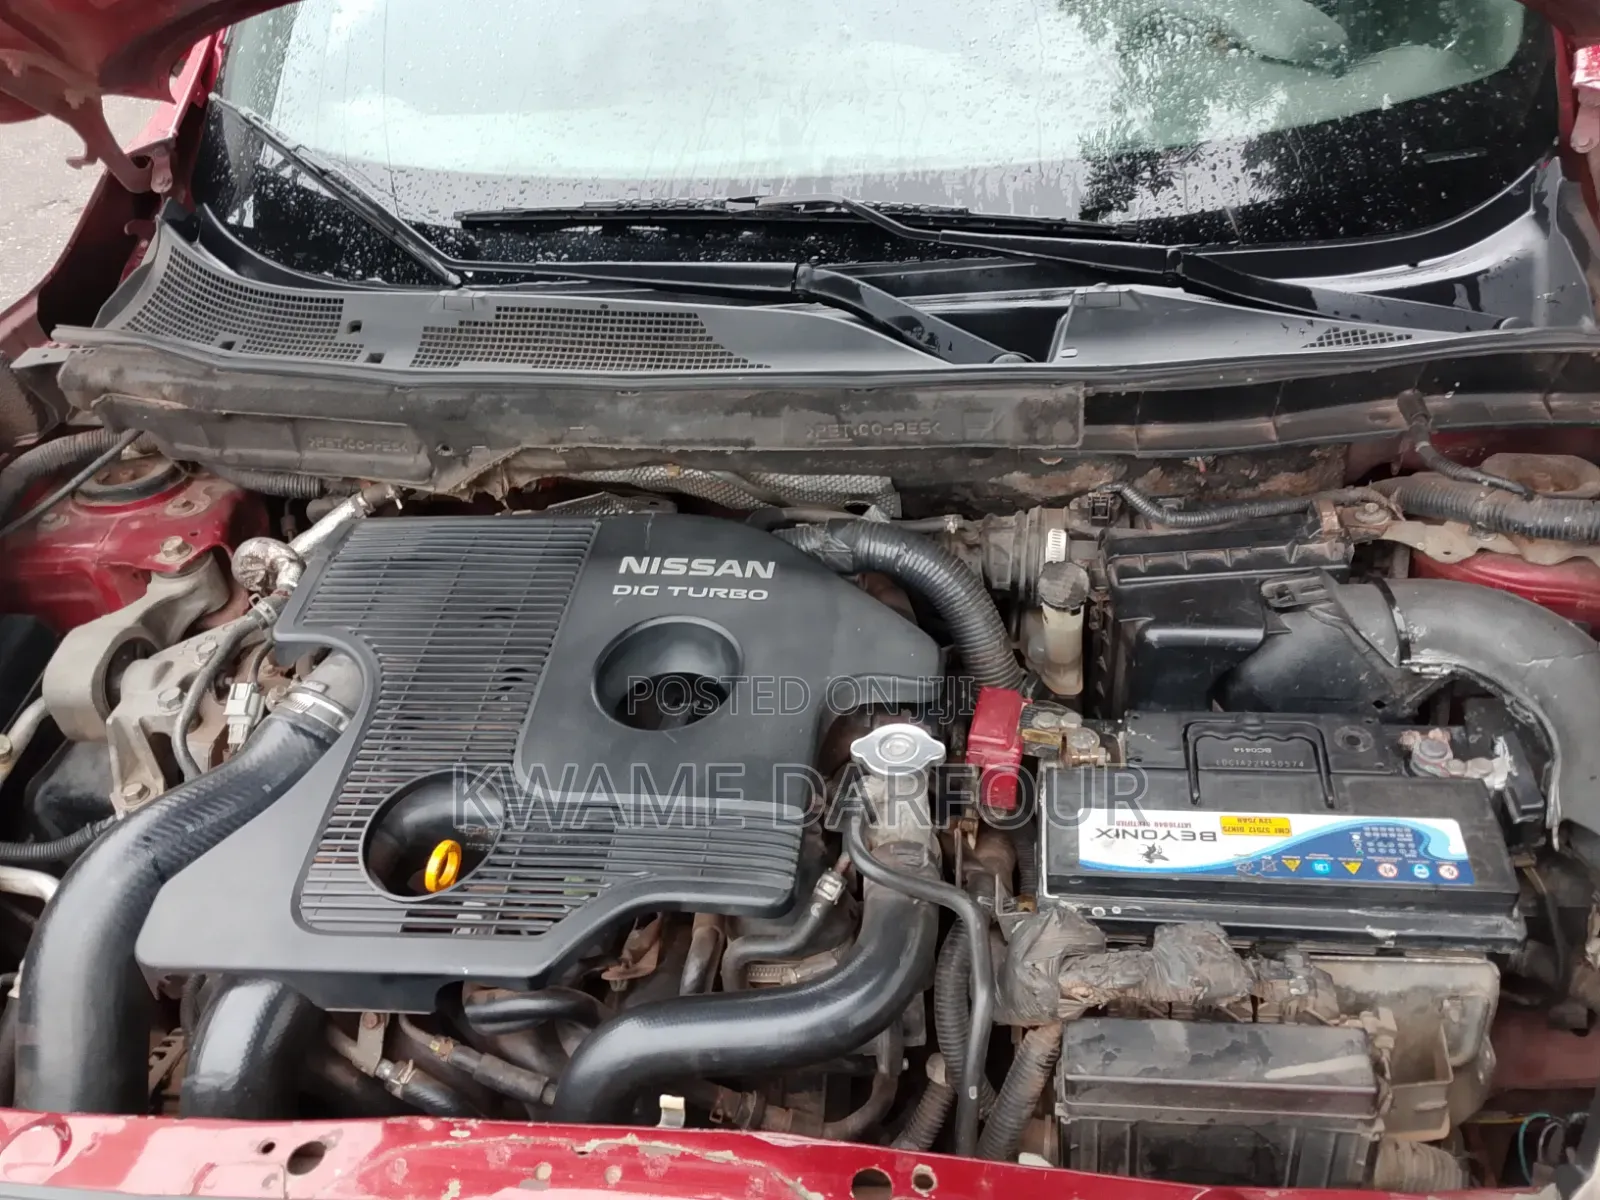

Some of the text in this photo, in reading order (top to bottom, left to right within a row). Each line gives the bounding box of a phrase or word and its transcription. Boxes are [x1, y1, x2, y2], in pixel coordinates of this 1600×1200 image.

[618, 556, 776, 579] NISSAN
[612, 585, 769, 601] DIG TURBO
[1095, 828, 1218, 842] BEYONIX
